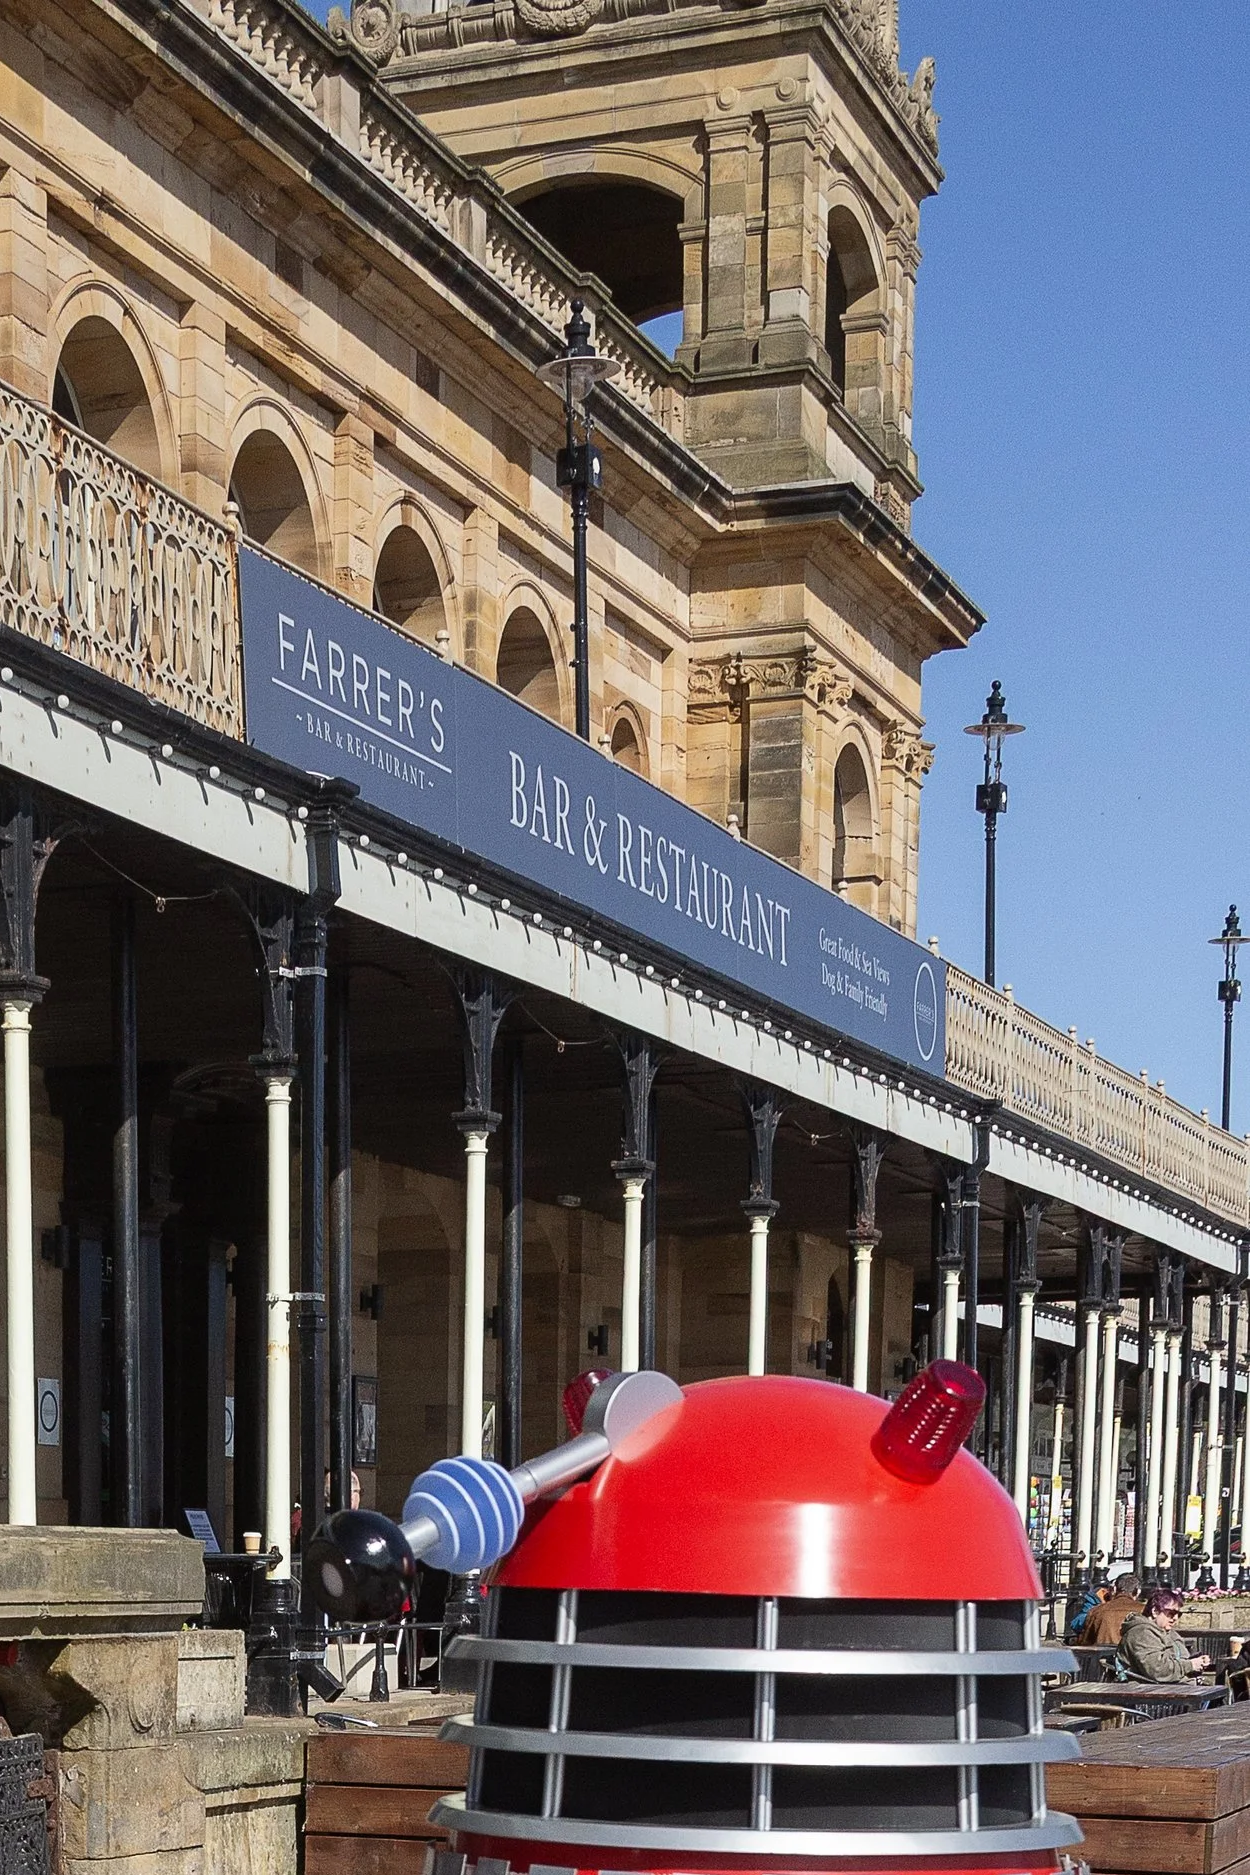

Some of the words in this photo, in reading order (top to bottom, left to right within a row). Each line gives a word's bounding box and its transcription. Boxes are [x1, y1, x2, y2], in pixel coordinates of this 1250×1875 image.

[278, 612, 445, 753] FARRER'S
[306, 712, 332, 744] BAR
[335, 731, 343, 749] &
[346, 732, 426, 790] RESTAURANT
[509, 751, 575, 855] BAR
[583, 795, 609, 874] &
[616, 812, 791, 967] RESTAURANT
[819, 927, 837, 957] Great
[838, 937, 854, 966] Food
[854, 946, 861, 971] &
[862, 951, 872, 976] Sea
[873, 957, 890, 986] Views
[822, 962, 836, 996] Dog
[836, 970, 843, 994] &
[844, 974, 864, 1010] Family
[864, 985, 888, 1022] Friendly
